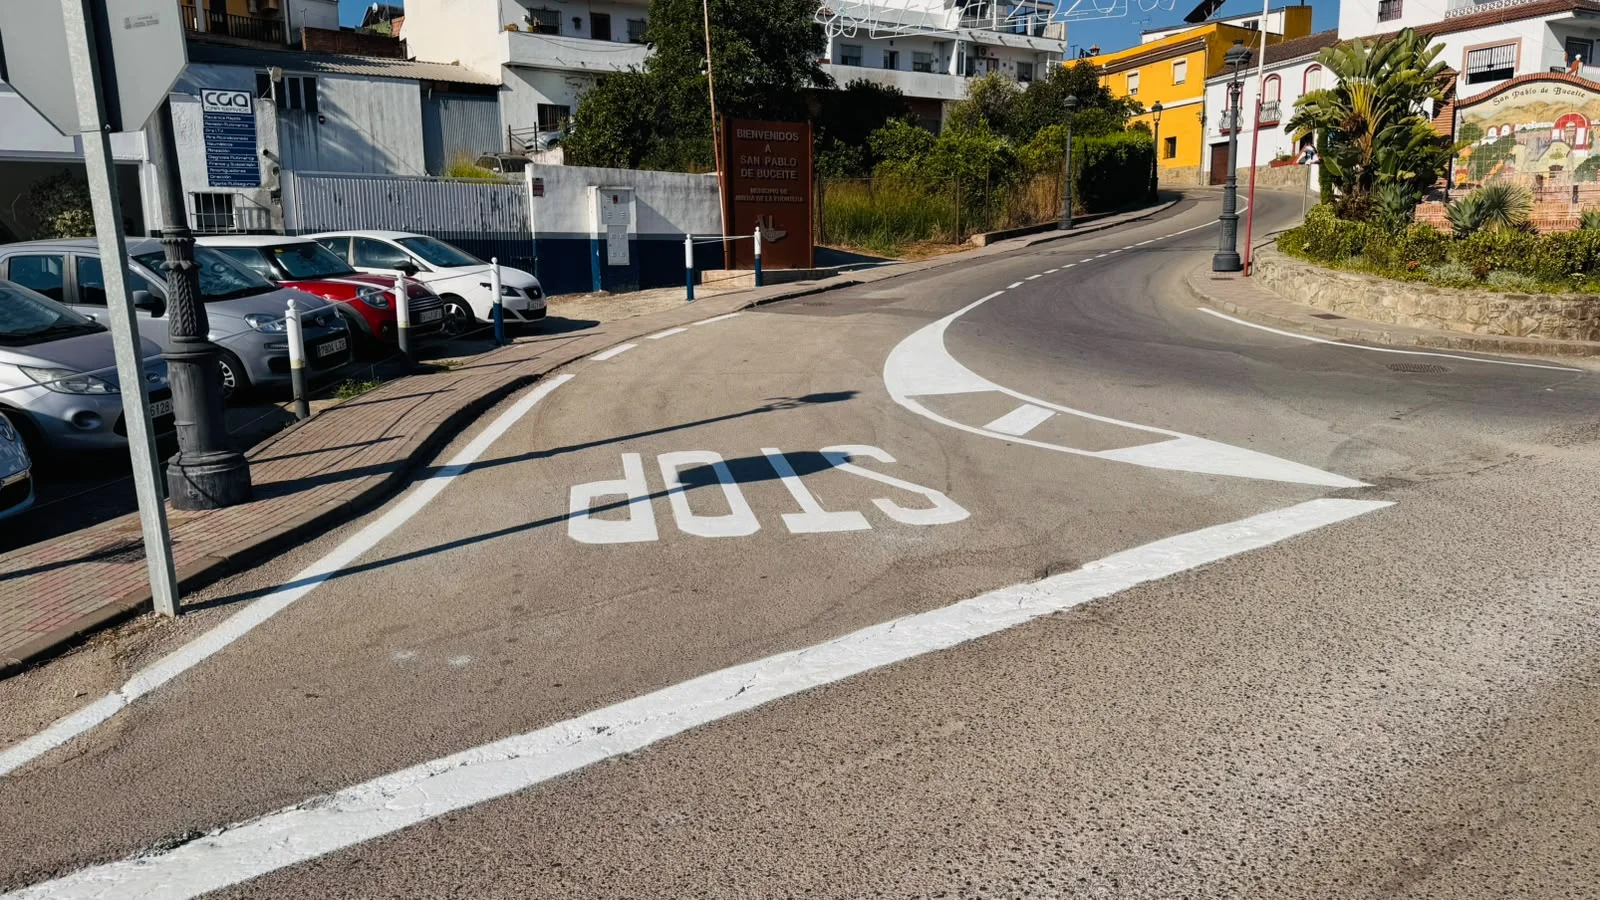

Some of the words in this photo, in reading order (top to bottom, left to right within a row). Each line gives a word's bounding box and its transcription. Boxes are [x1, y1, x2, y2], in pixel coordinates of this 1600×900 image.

[1492, 95, 1510, 106] San
[1512, 87, 1537, 99] Pablo
[736, 128, 799, 141] BIENVENIDOS
[765, 144, 772, 153] A
[740, 155, 760, 165] SAN
[765, 156, 797, 167] PABLO
[741, 168, 754, 178] DE
[757, 169, 797, 179] BUCEITE
[567, 444, 972, 544] STOP
